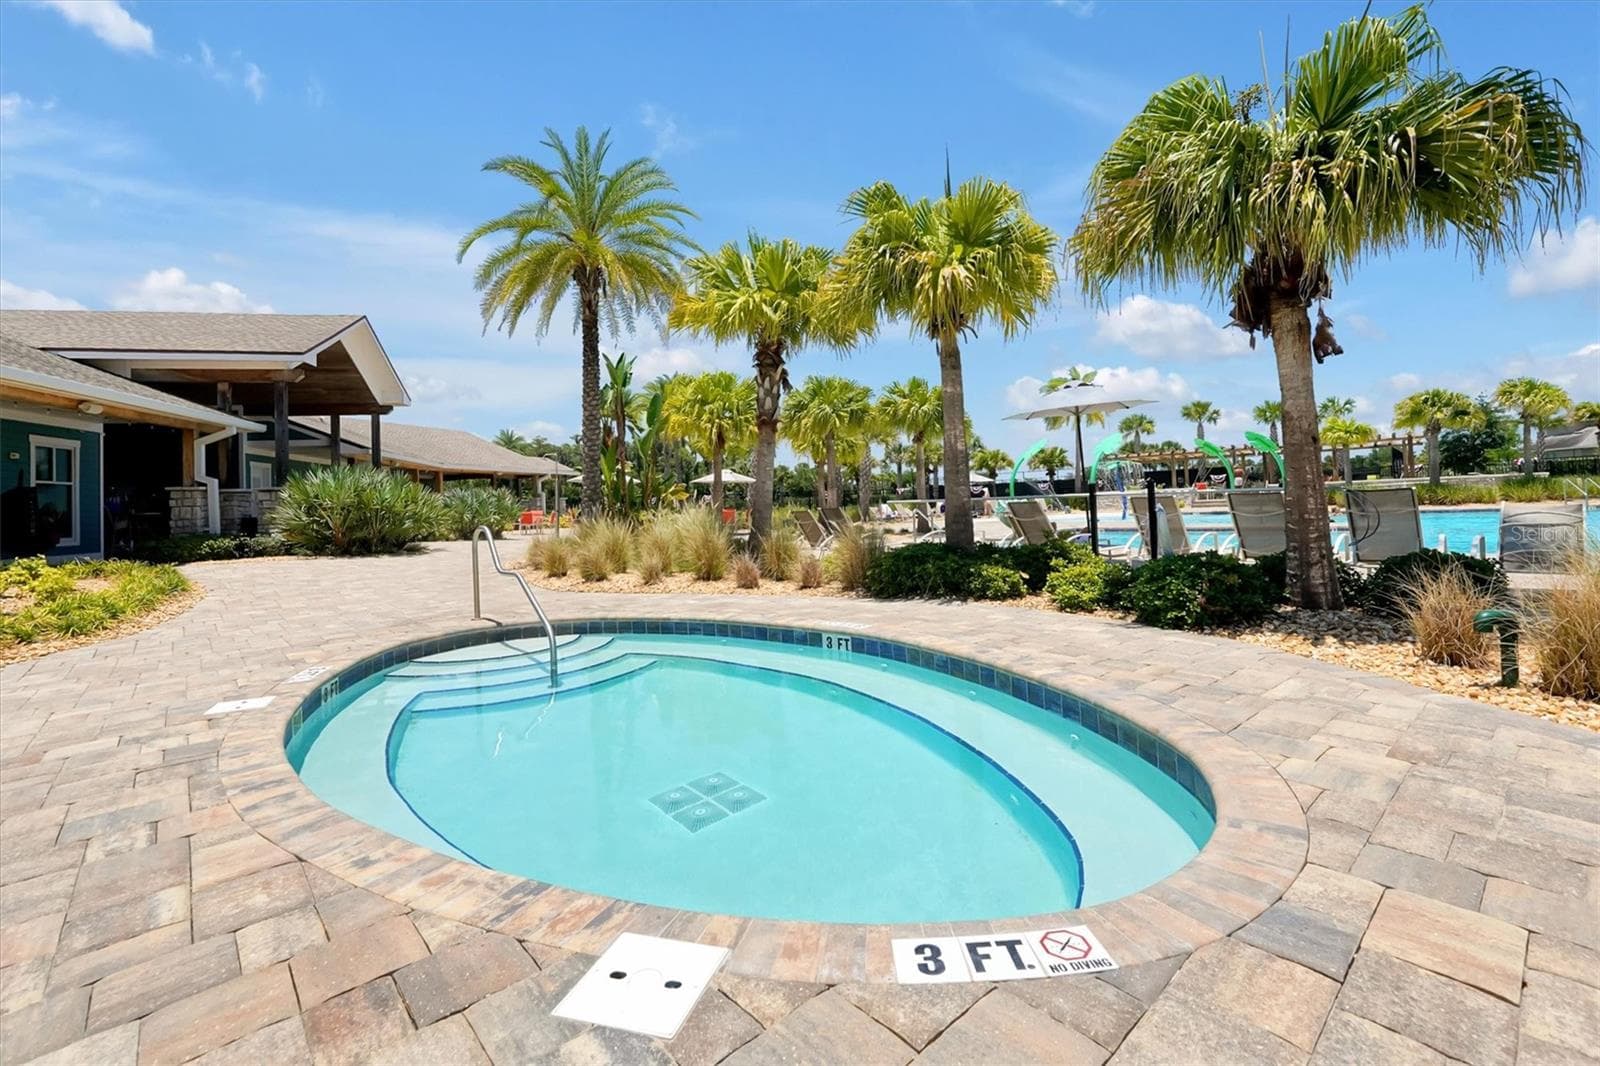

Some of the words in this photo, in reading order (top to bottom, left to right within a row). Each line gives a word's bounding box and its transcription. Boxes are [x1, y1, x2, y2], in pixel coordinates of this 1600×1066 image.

[826, 636, 833, 649] 3
[837, 638, 850, 651] FT
[914, 943, 946, 976] 3
[965, 939, 1036, 973] FT.
[1049, 963, 1068, 973] NO
[1069, 958, 1113, 971] DIVING
